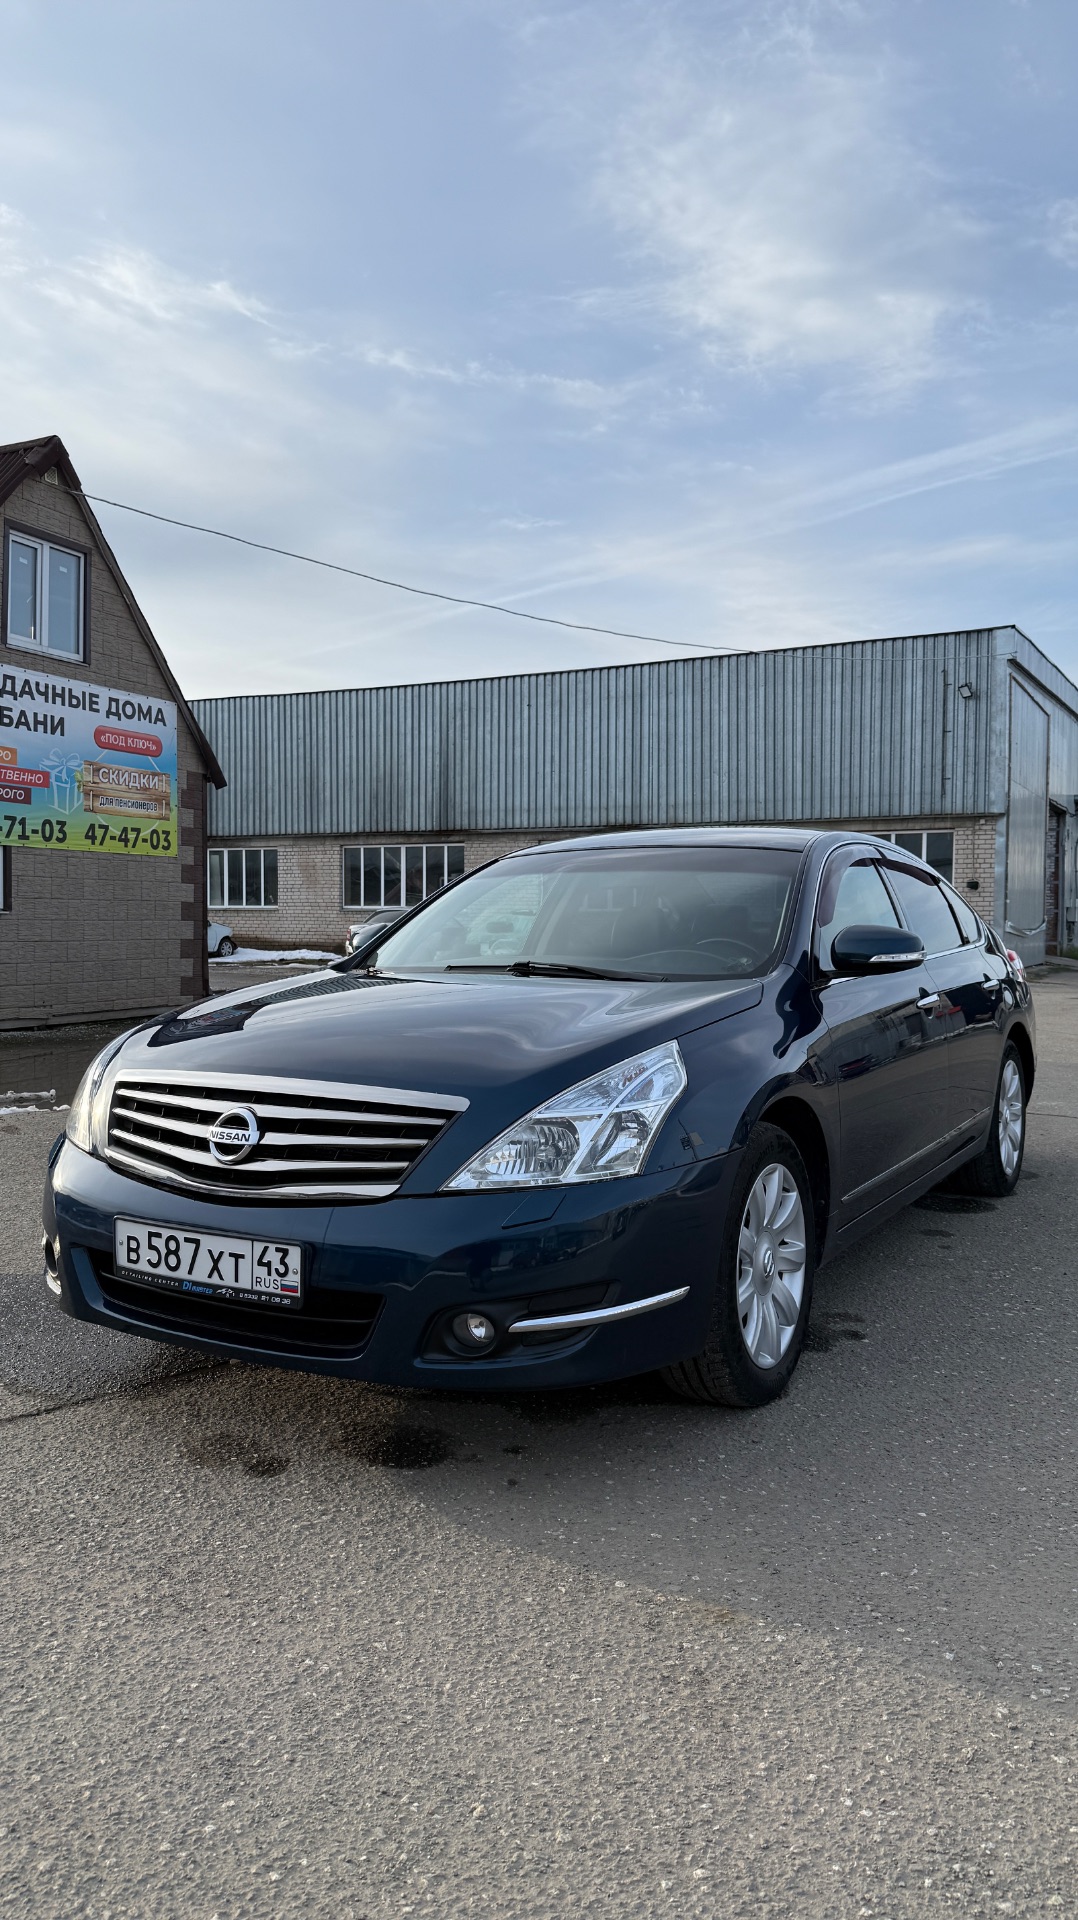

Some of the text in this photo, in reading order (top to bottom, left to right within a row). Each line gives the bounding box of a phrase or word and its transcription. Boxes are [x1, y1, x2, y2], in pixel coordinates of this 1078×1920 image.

[0, 673, 167, 727] ДАЧНЫЕ ДОМА
[0, 705, 65, 737] БАНИ
[100, 733, 157, 752] «ПОД КЛЮЧ»
[0, 769, 44, 784] ТВЕННО
[98, 767, 159, 790] СКИДКИ
[99, 796, 158, 812] для пенсионеров
[84, 823, 172, 851] 47-47-03
[209, 1130, 251, 1142] NISSAN
[256, 1245, 290, 1278] 43
[255, 1276, 280, 1290] RUS
